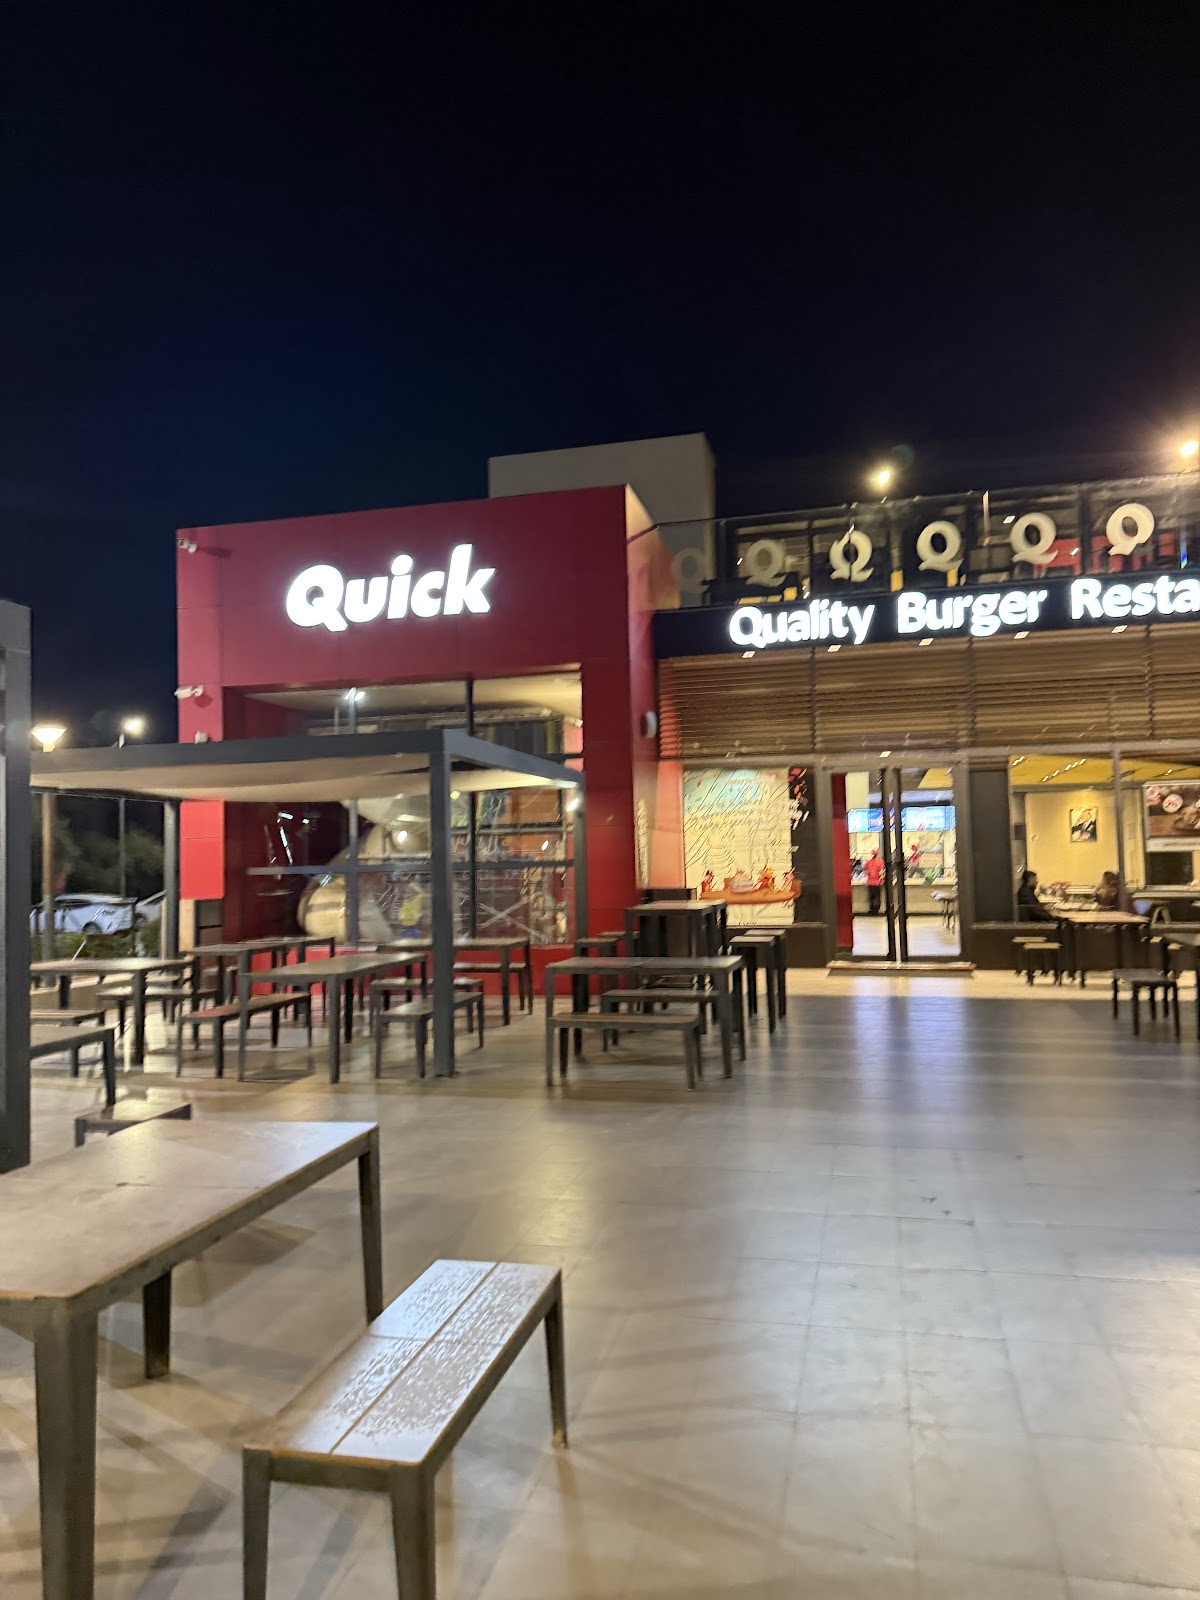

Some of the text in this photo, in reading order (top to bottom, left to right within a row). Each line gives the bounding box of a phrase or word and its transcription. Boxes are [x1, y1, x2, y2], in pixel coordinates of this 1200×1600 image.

[745, 539, 787, 587] Q
[829, 530, 874, 582] Q
[916, 520, 964, 572] Q
[1010, 512, 1059, 565] Q
[1105, 503, 1156, 556] Q
[285, 543, 496, 632] Quick
[728, 574, 1200, 649] Quality Burger Resta
